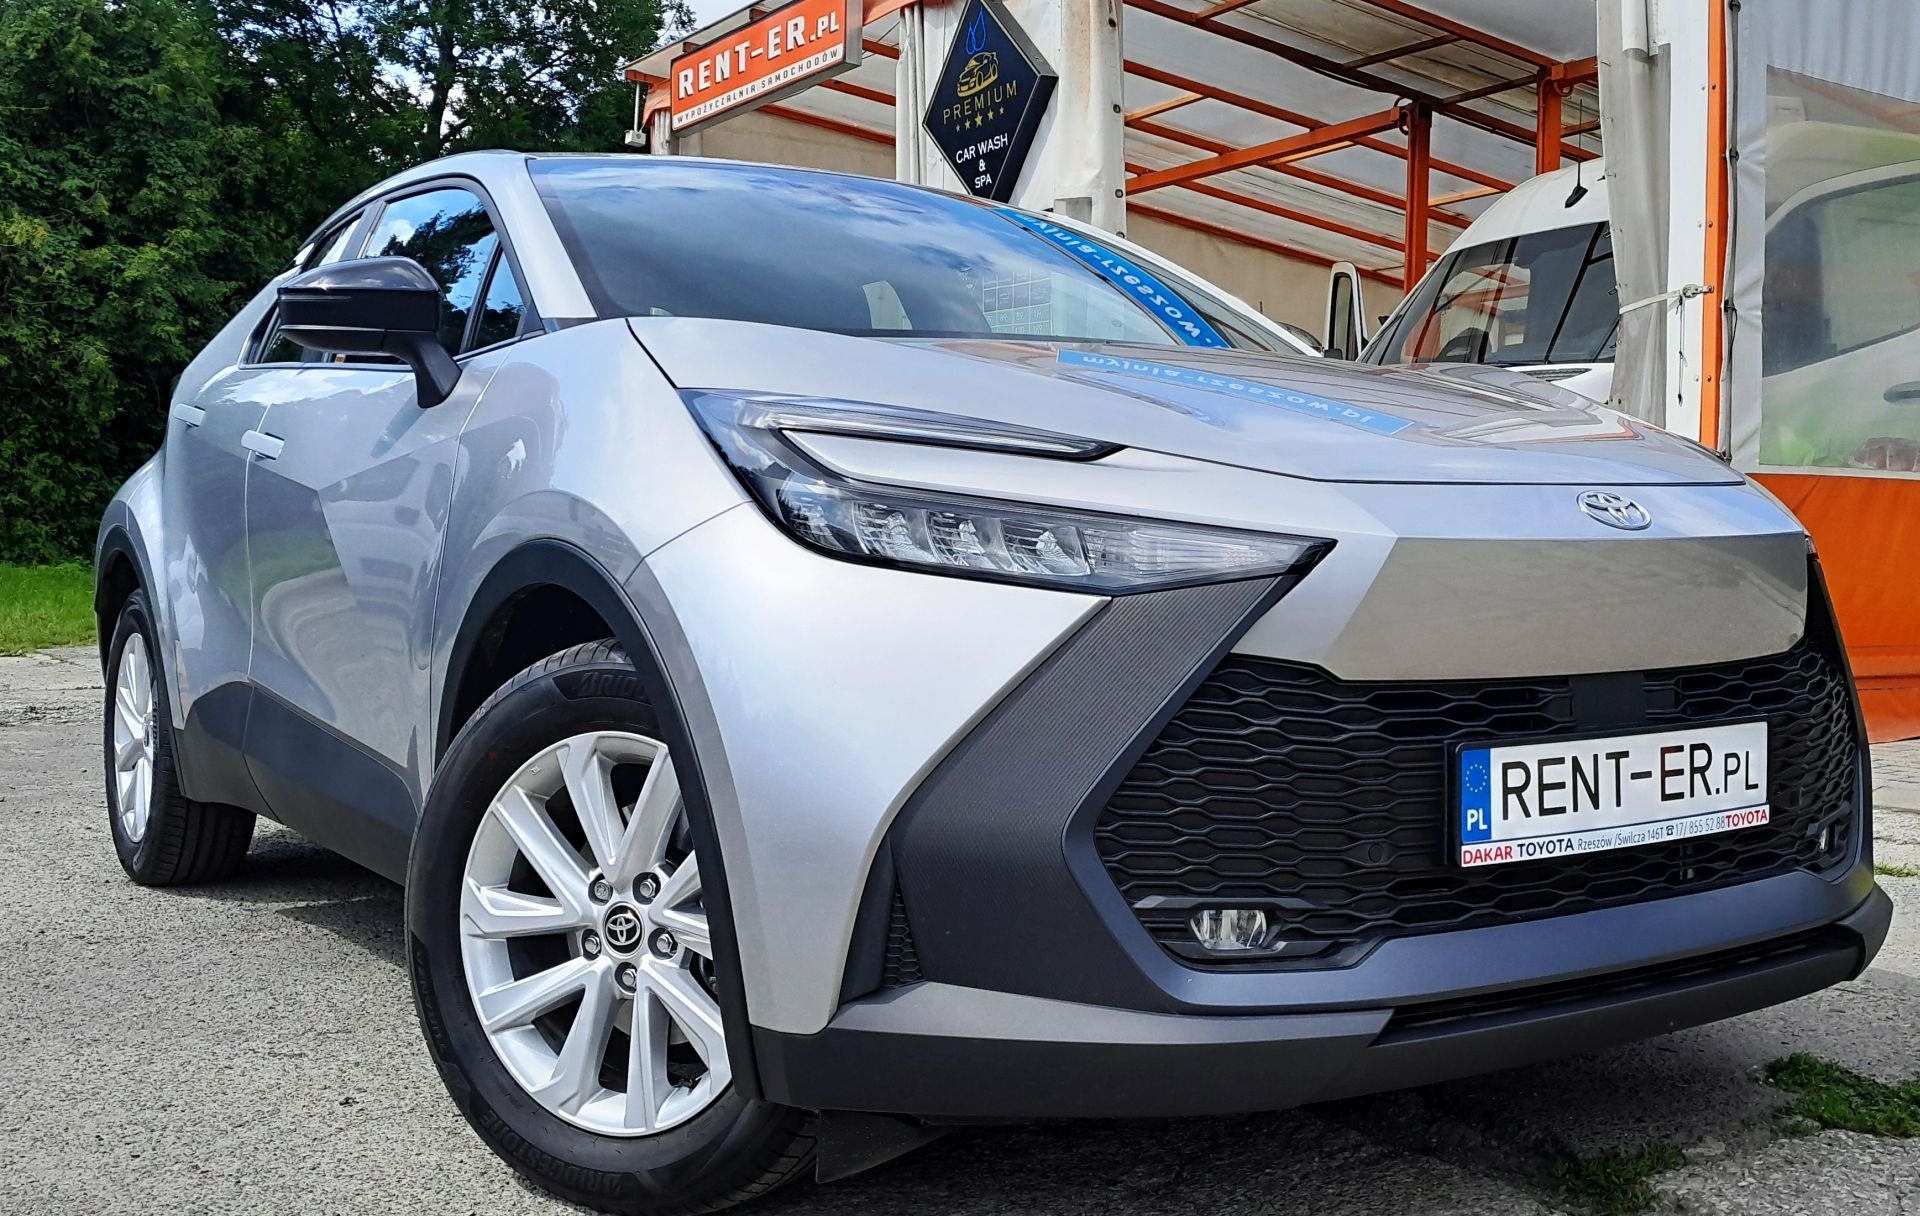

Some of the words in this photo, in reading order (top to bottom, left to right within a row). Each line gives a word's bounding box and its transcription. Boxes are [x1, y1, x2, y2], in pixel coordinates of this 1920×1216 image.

[678, 11, 840, 100] RENT-ER.PL
[677, 84, 756, 124] WYPOŻYCZALNIA
[761, 48, 838, 89] SAMOCHODÓW
[943, 79, 1018, 125] PREMIUM
[955, 145, 976, 164] CAR
[977, 132, 1009, 156] WASH
[978, 158, 987, 172] &
[974, 172, 993, 189] SPA
[1501, 741, 1759, 820] RENT-ER.PL
[1462, 846, 1513, 865] DAKAR
[1517, 838, 1575, 858] TOYOTA
[1577, 837, 1613, 851] Rzeszów
[1689, 820, 1703, 835] 855
[1705, 818, 1714, 833] 52
[1715, 816, 1725, 830] 88
[1725, 809, 1768, 829] TOYOTA
[1466, 808, 1488, 832] PL
